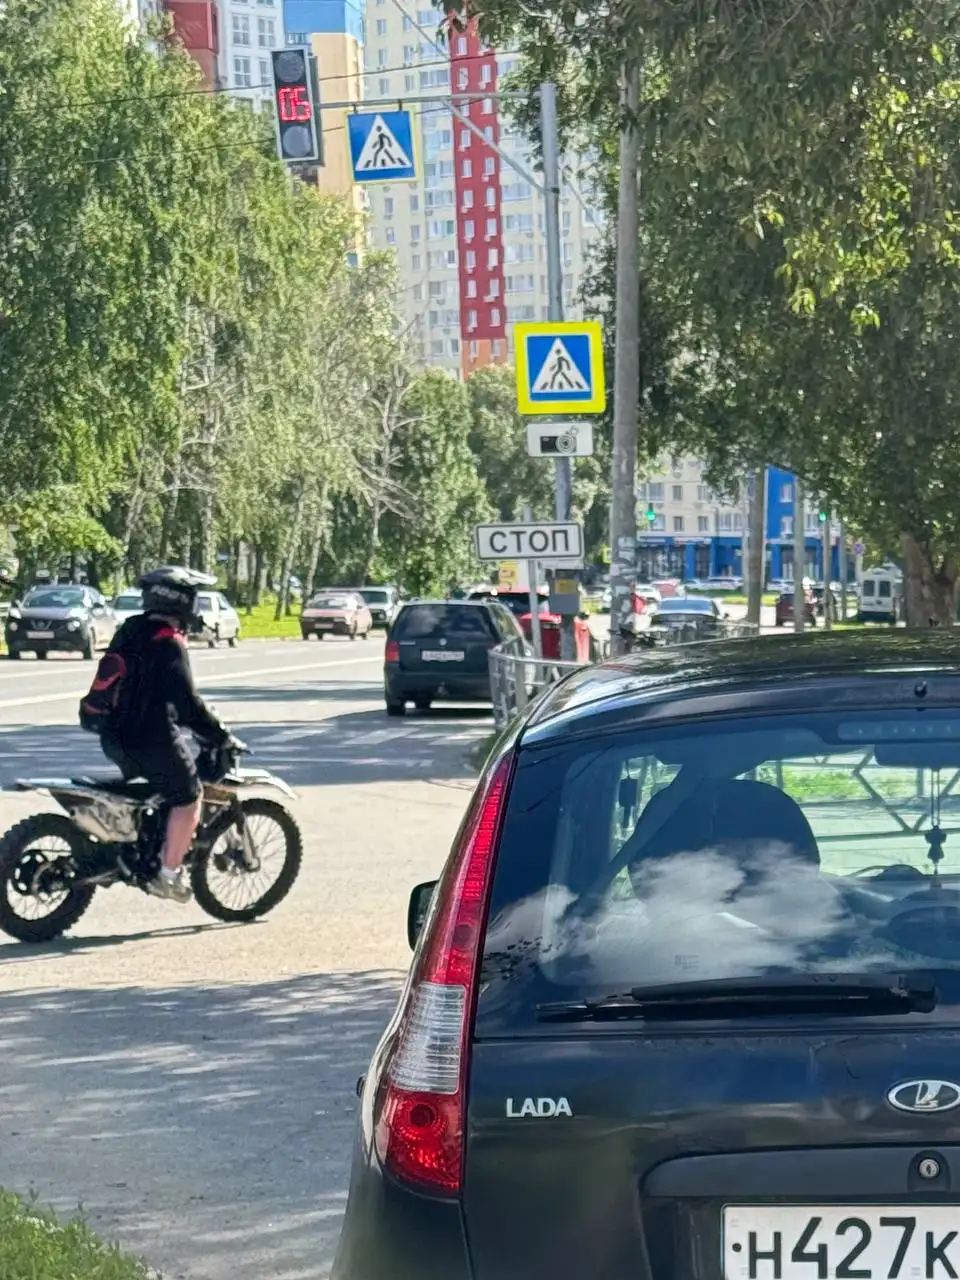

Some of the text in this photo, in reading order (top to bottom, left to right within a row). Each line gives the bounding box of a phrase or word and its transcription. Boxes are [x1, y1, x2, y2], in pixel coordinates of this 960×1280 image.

[279, 86, 312, 122] 05
[489, 530, 570, 553] СТОП
[506, 1097, 573, 1117] LADA
